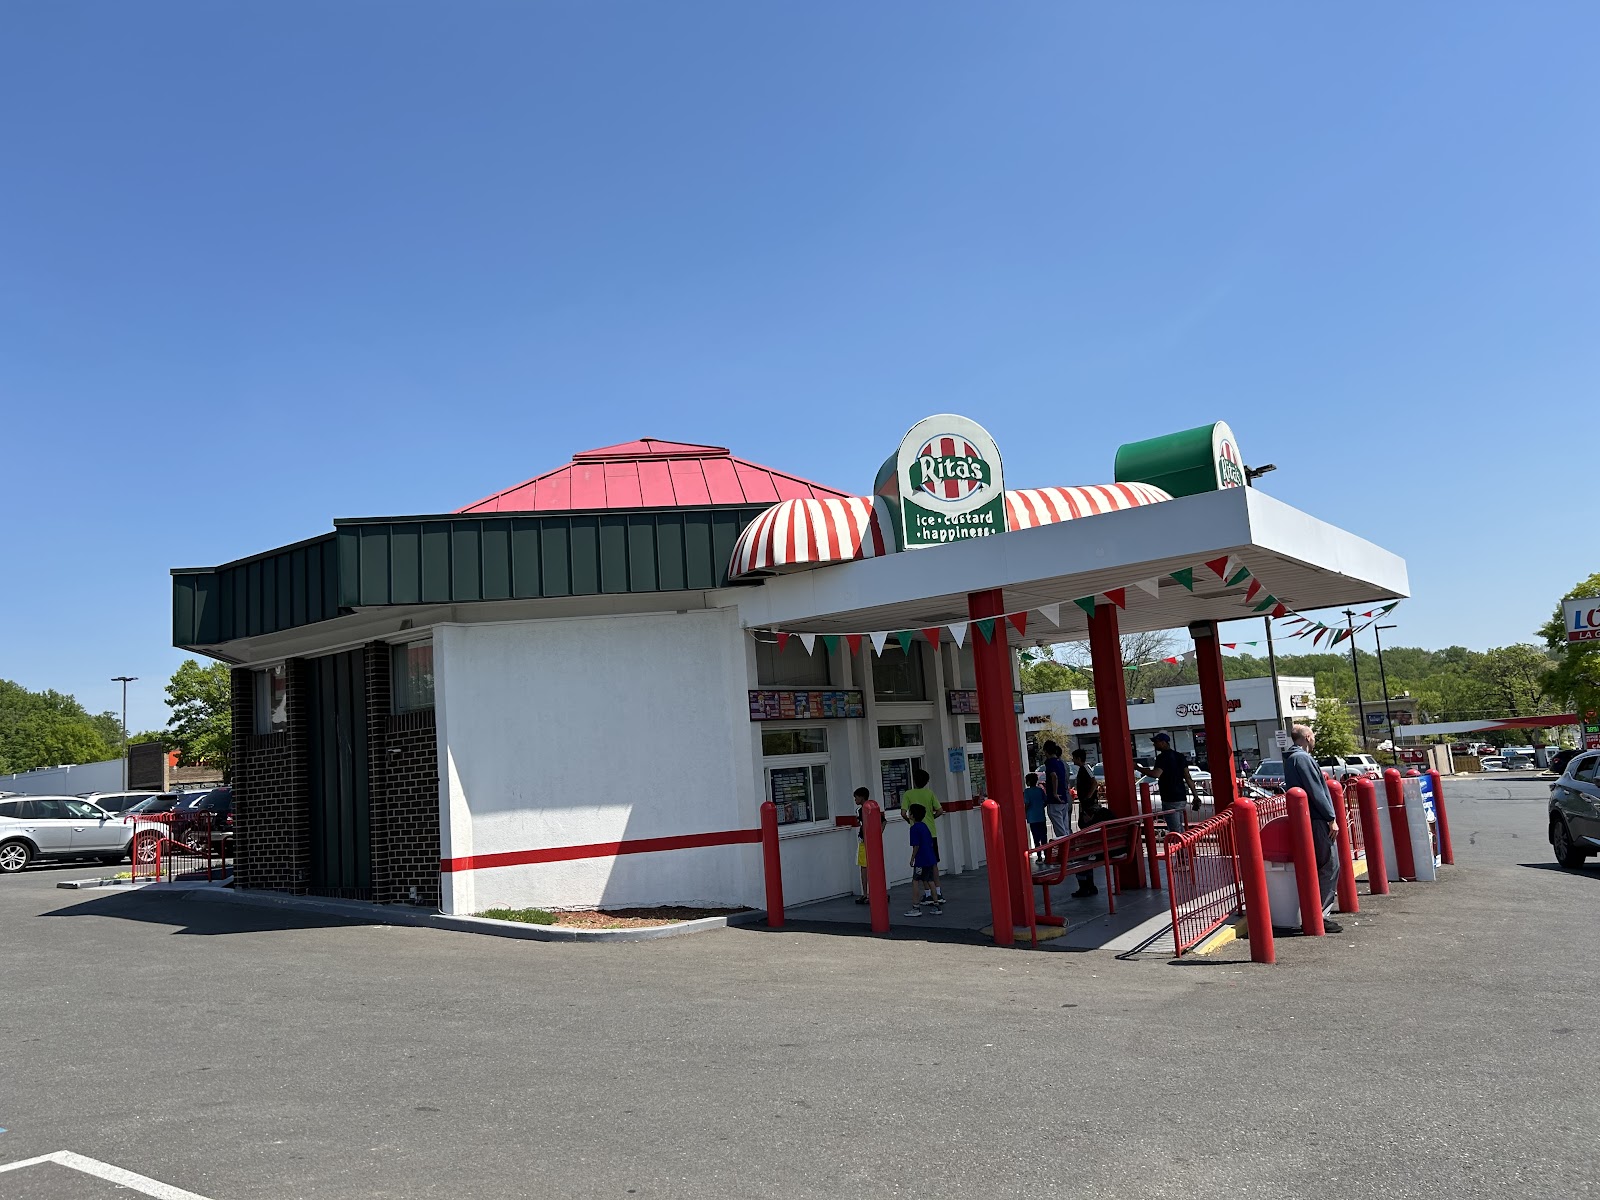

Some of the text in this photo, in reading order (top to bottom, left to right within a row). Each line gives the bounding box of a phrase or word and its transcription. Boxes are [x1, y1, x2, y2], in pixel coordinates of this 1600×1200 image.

[919, 455, 983, 484] Rita's
[916, 510, 993, 526] ice custard
[922, 526, 990, 542] happiness
